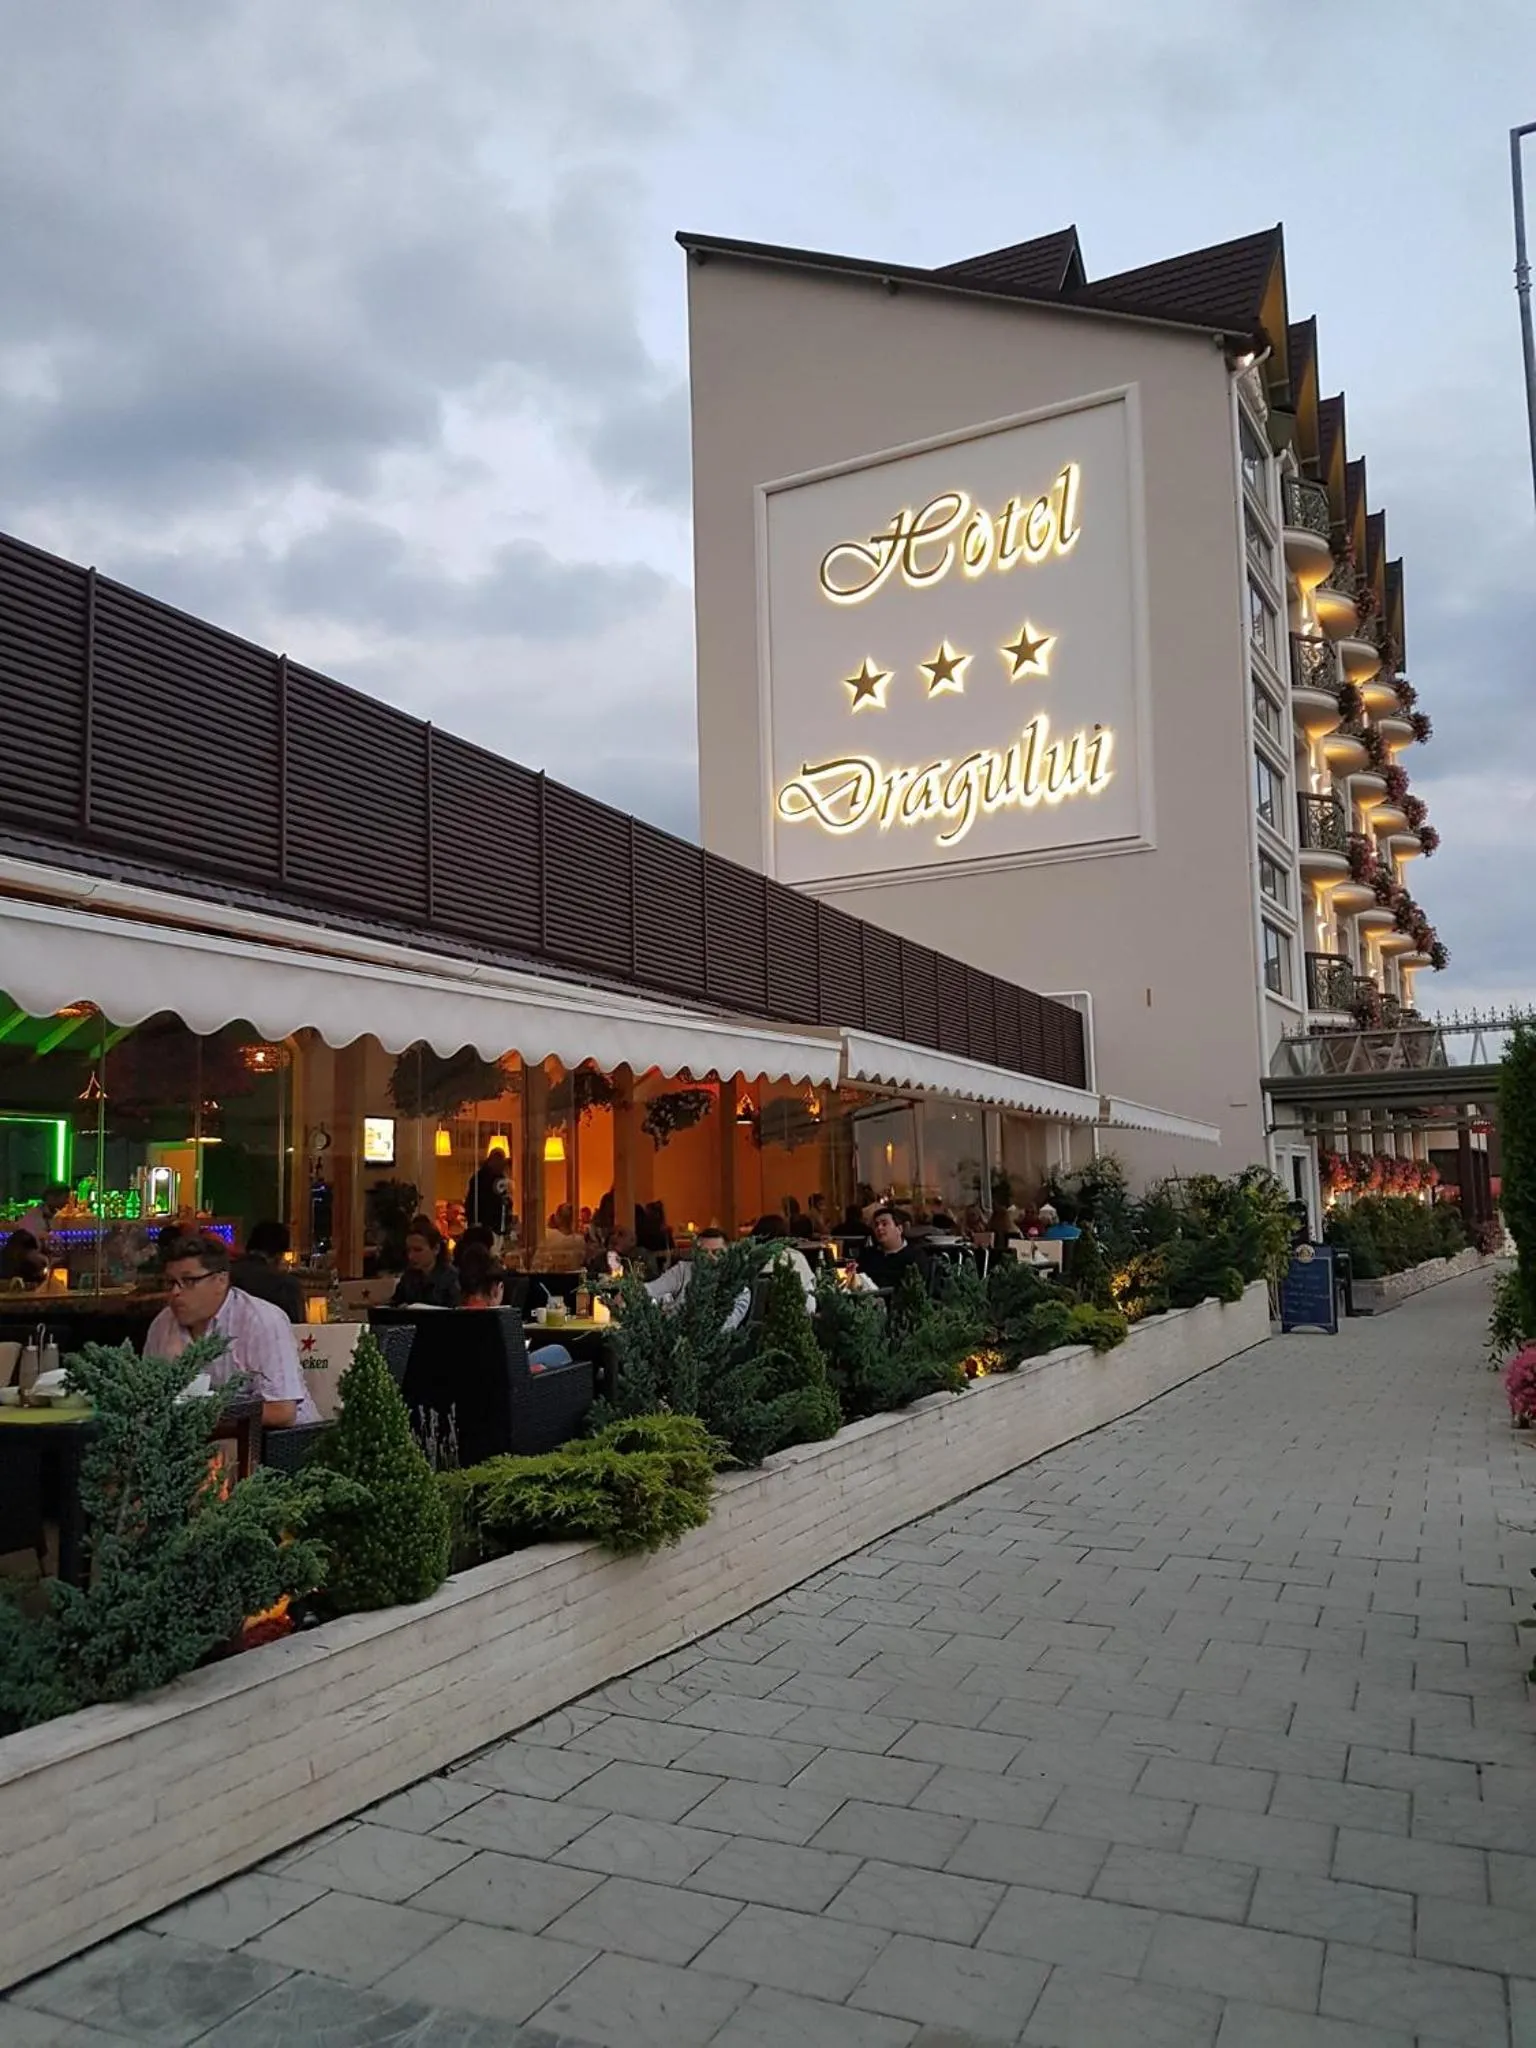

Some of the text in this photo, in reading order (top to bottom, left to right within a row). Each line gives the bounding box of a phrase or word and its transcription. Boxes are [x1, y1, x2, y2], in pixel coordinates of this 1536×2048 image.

[820, 463, 1080, 602] Hotel
[778, 714, 1113, 845] Dragului
[300, 1355, 329, 1369] eken
